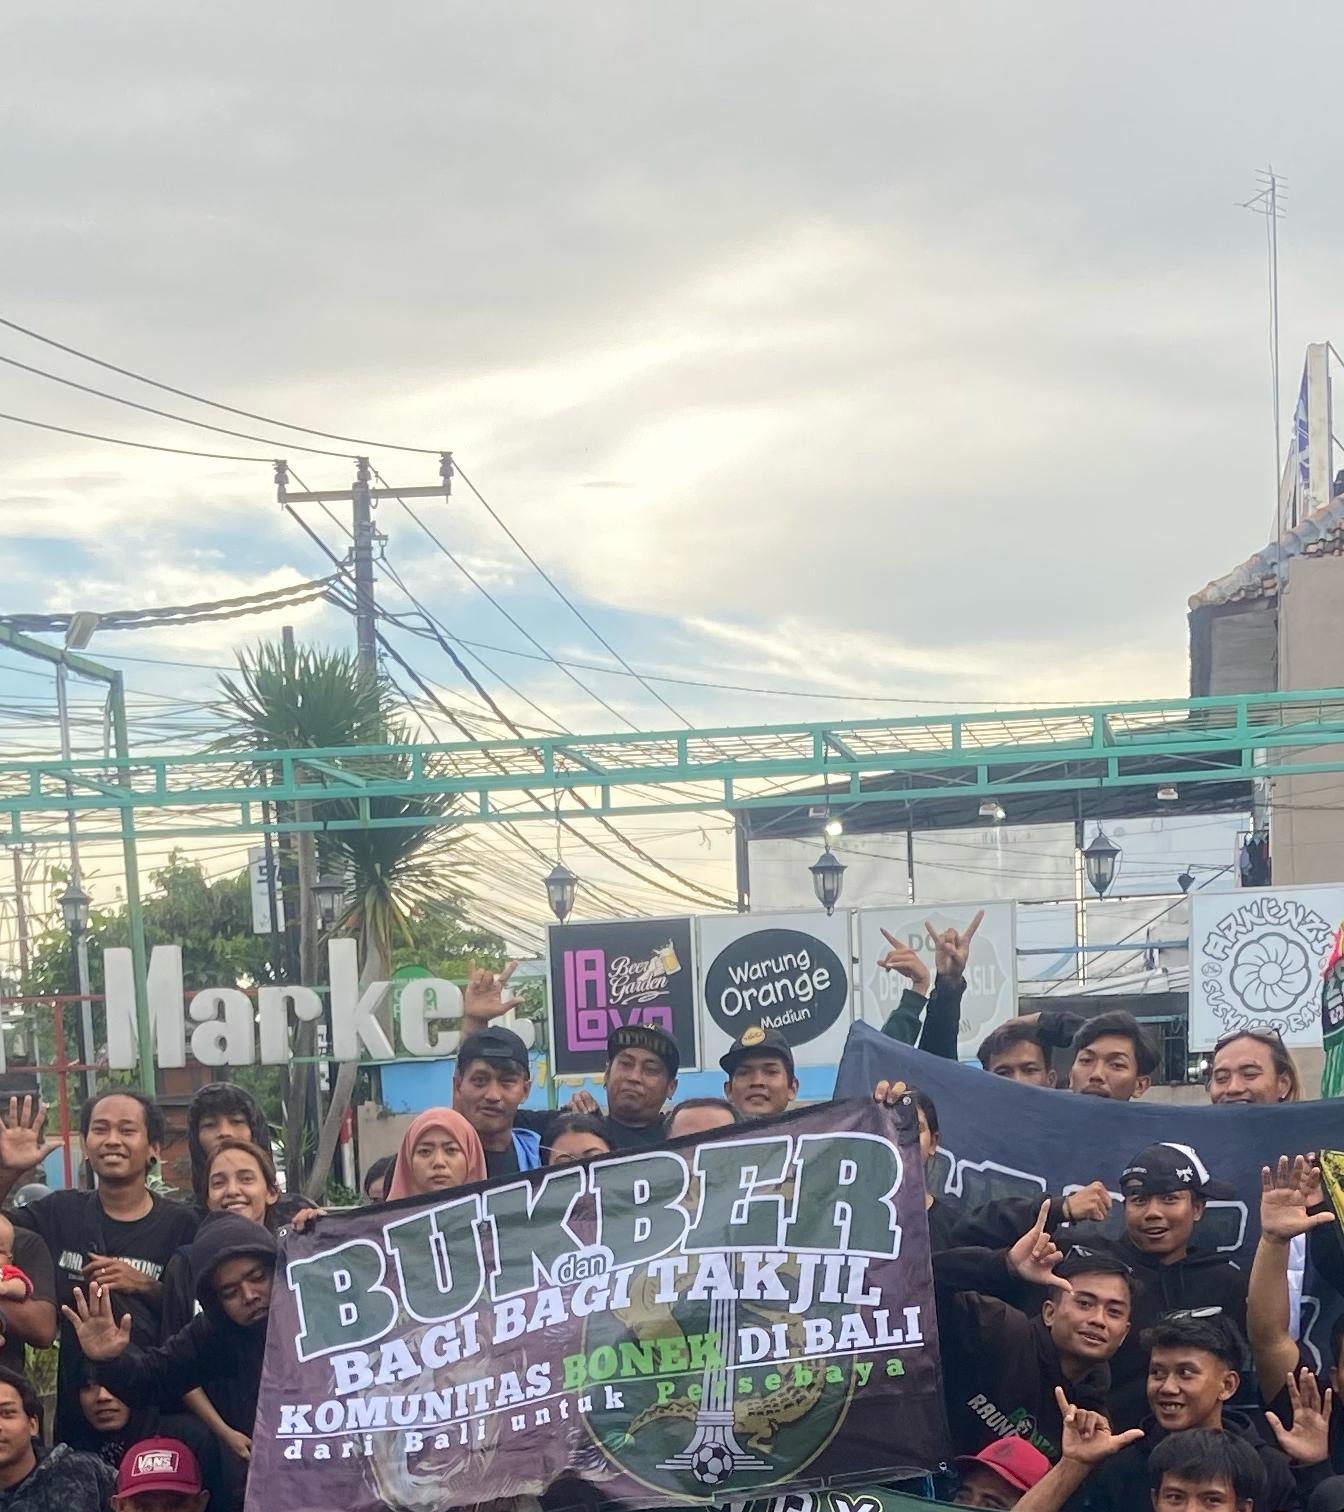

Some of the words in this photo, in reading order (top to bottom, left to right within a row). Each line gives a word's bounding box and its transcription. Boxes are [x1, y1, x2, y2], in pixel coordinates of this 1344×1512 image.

[609, 972, 668, 1005] Garden
[728, 950, 811, 985] Warung
[720, 965, 832, 1017] Orange
[760, 1007, 812, 1031] Madiun
[287, 1130, 904, 1363] BUKBER
[557, 1249, 609, 1285] dan
[330, 1319, 481, 1398] BAGI
[492, 1267, 633, 1346] BAGI
[654, 1251, 883, 1314] TAKJIL
[277, 1362, 552, 1438] KOMUNITAS
[564, 1331, 723, 1391] BONEK
[738, 1323, 793, 1363] DI
[803, 1305, 923, 1357] BALI
[283, 1433, 375, 1462] dari
[403, 1422, 487, 1456] Bali
[511, 1384, 625, 1434] untuk
[137, 1453, 174, 1473] VANS
